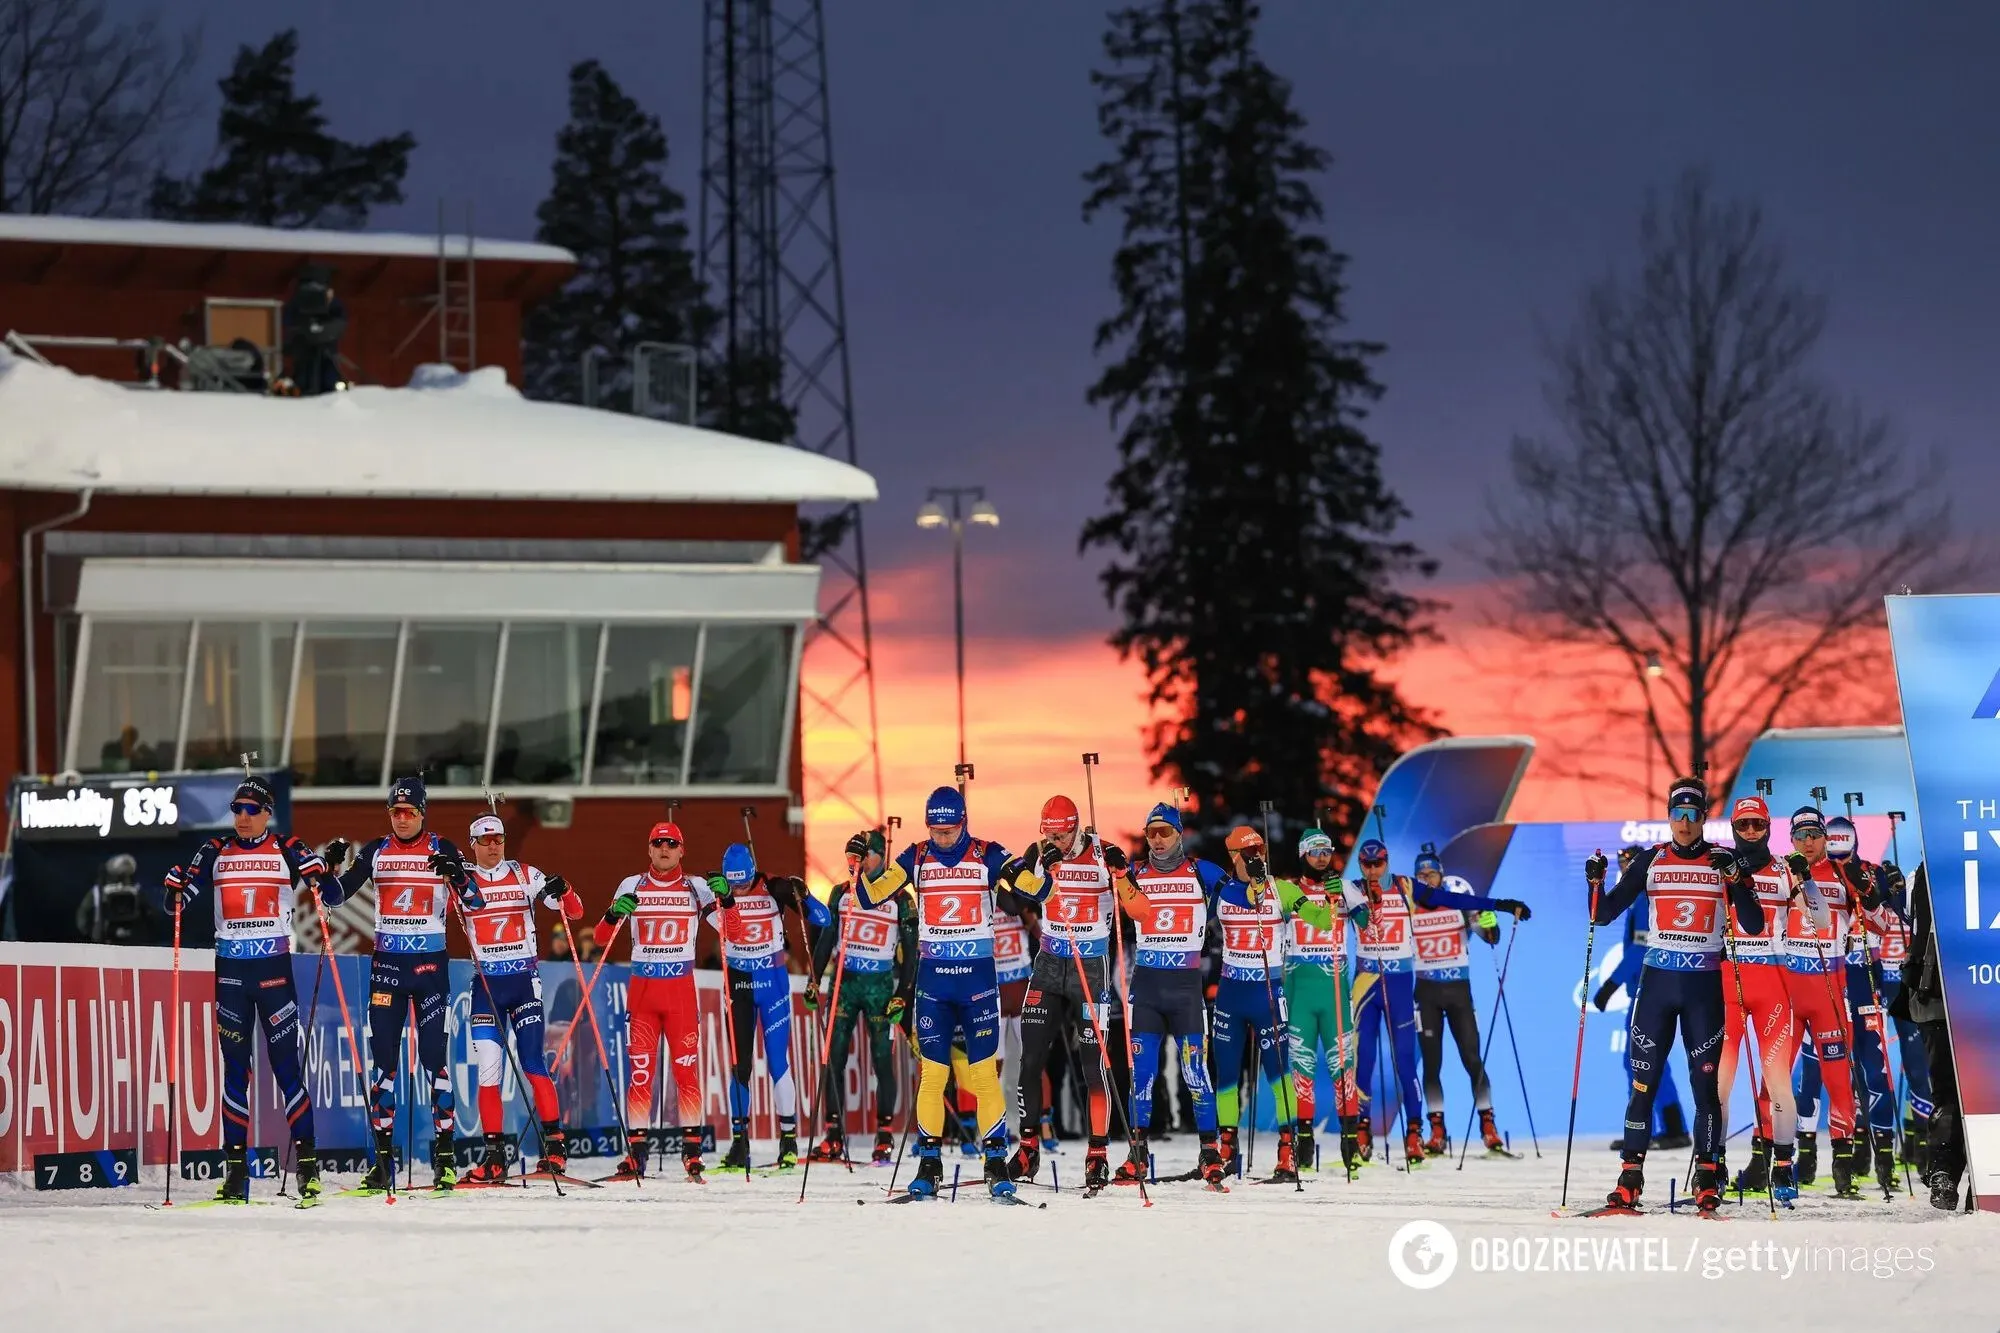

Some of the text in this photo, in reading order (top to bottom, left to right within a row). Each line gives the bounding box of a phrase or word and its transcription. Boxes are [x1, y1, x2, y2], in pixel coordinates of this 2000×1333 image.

[394, 788, 411, 796] ice
[21, 788, 178, 836] Humidity 83%
[219, 861, 280, 872] BAUHAUS
[921, 869, 981, 880] BAUHAUS
[1058, 871, 1098, 881] UHAUS
[1654, 872, 1718, 884] BAUHAUS
[240, 887, 257, 915] 1
[393, 888, 415, 912] 4
[484, 891, 524, 902] UHAUS
[939, 896, 962, 924] 2
[970, 908, 978, 923] 1
[1061, 897, 1095, 921] 5 1
[1672, 901, 1711, 931] 3 1
[226, 921, 275, 930] ÖSTERSUND
[382, 918, 428, 926] ÖSTERSUND
[1153, 907, 1190, 932] 8 1
[1413, 915, 1459, 927] BAUHAUS
[489, 916, 524, 941] 7 1
[643, 919, 687, 943] 10 1
[744, 922, 764, 942] 3
[400, 937, 428, 951] iX2
[1144, 936, 1188, 944] ÖSTERSUND
[1659, 933, 1707, 943] ÖSTERSUND
[250, 939, 278, 956] iX2
[482, 944, 524, 954] ÖSTERSUND
[642, 946, 684, 954] ÖSTERSUND
[845, 944, 880, 953] STERSUND
[950, 942, 979, 958] iX2
[1421, 937, 1453, 957] 20
[751, 956, 775, 971] iX2
[856, 959, 880, 971] iX2
[1161, 952, 1187, 967] iX2
[1676, 954, 1705, 968] iX2
[1804, 958, 1831, 971] iX2
[378, 963, 400, 971] LAPUA
[502, 960, 528, 974] iX2
[660, 963, 684, 976] iX2
[1440, 968, 1461, 979] iX2
[1241, 970, 1266, 982] iX2
[420, 1008, 440, 1027] CRAFT
[217, 1024, 243, 1042] omfy
[270, 1021, 295, 1043] CRAFT
[1764, 1022, 1792, 1068] RAIFFEISEN
[570, 1136, 617, 1154] 20 21
[45, 1161, 128, 1185] 7 8 9
[185, 1161, 211, 1179] 10
[346, 1158, 368, 1174] 14
